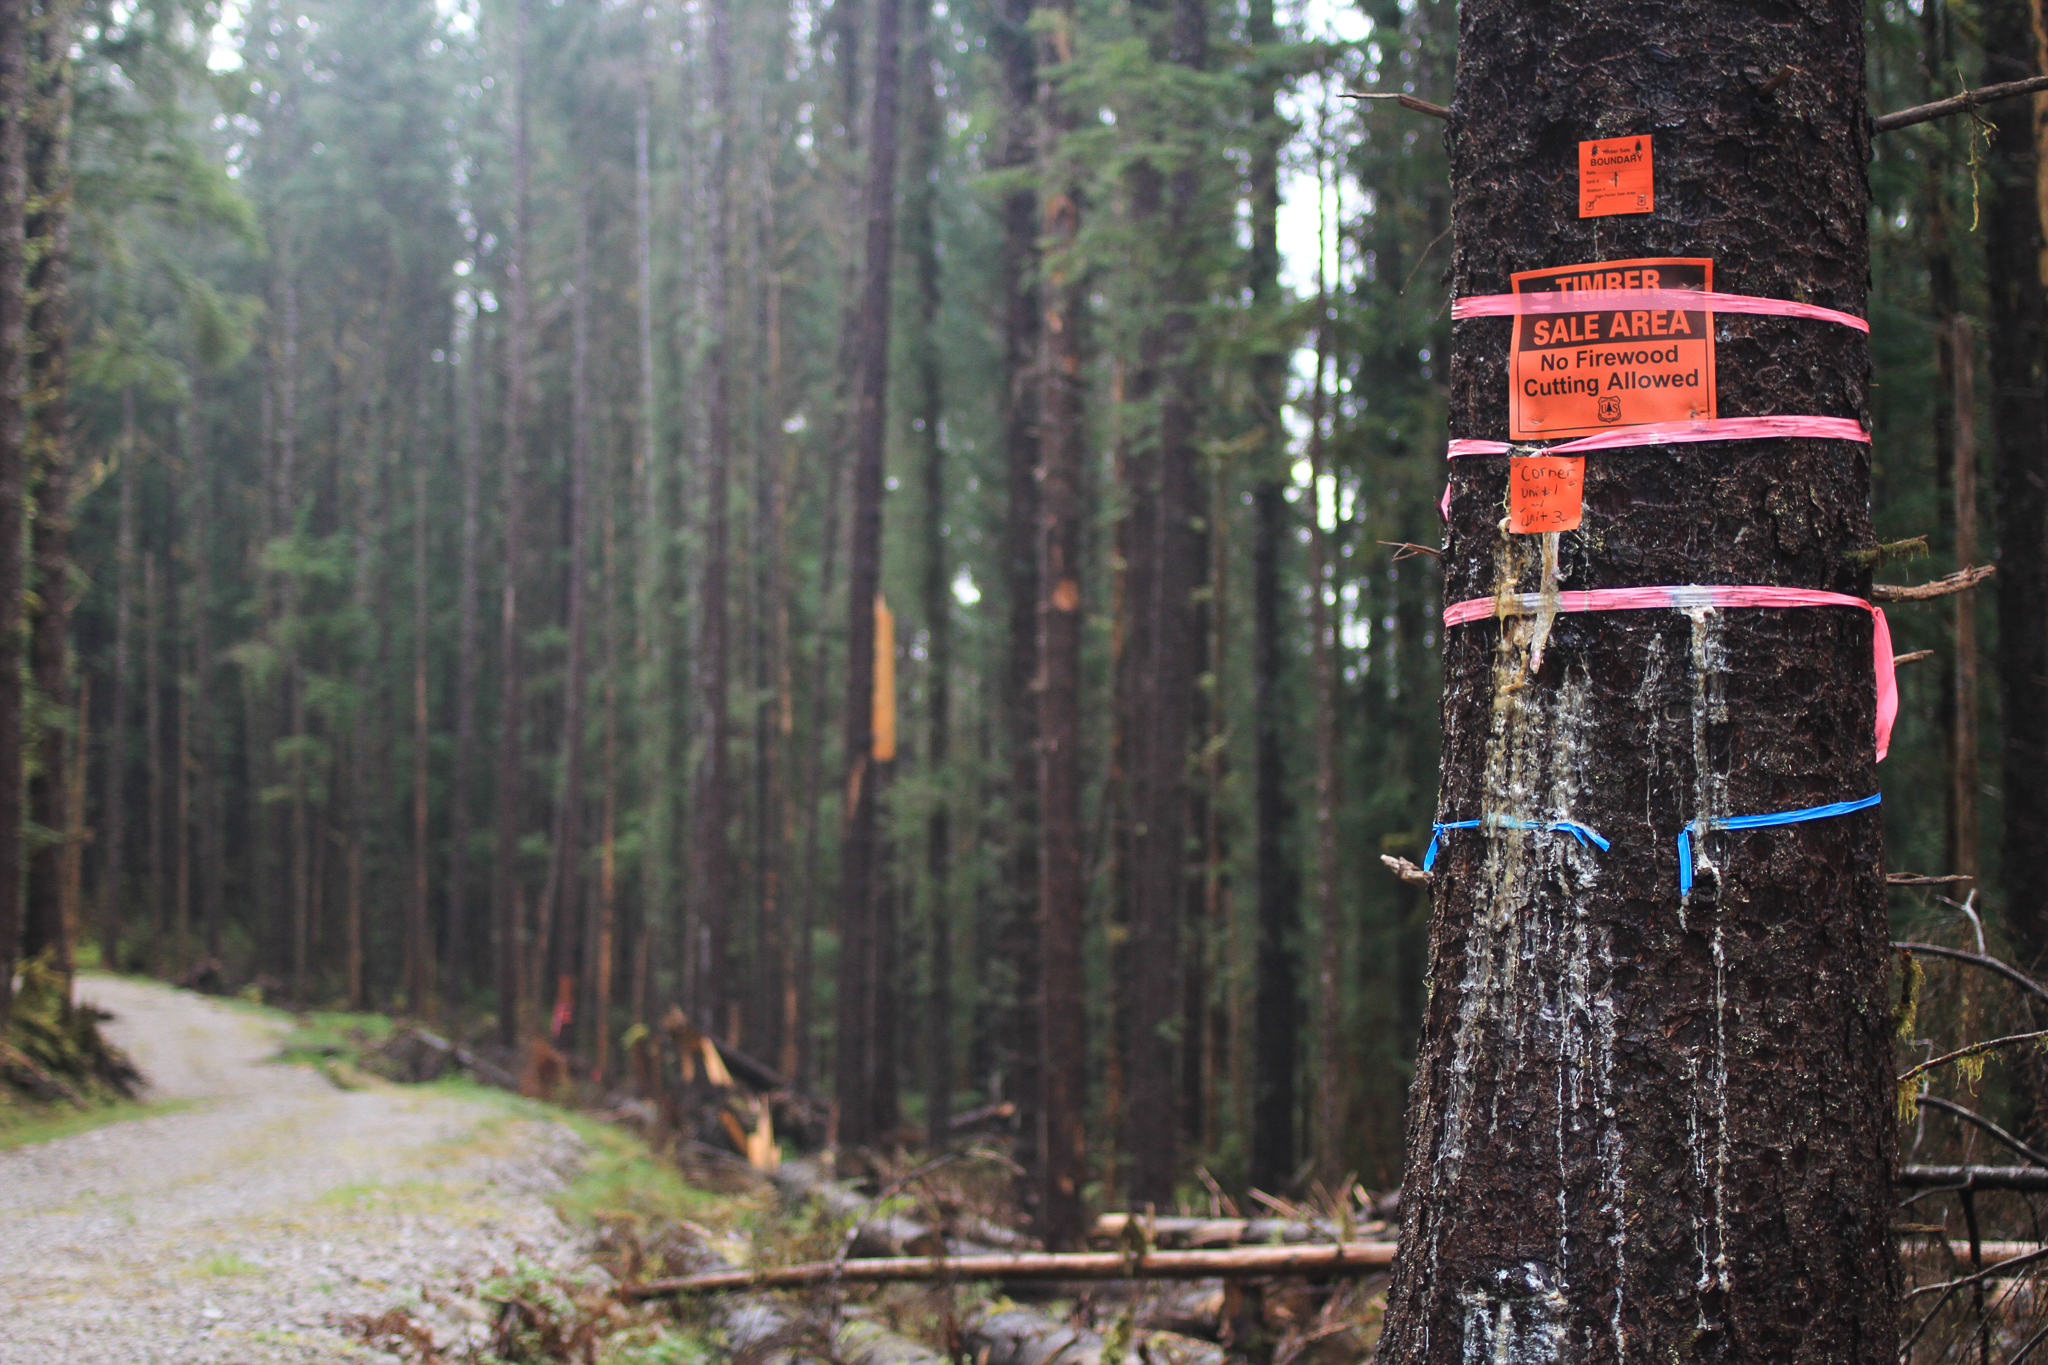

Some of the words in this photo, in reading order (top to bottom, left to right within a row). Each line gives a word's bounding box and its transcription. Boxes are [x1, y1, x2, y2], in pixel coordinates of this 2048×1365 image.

[1590, 154, 1643, 166] BOUNDARY
[1555, 269, 1660, 303] TIMBER
[1533, 314, 1599, 346] SALE
[1609, 309, 1691, 338] AREA
[1541, 354, 1569, 371] No
[1576, 345, 1679, 368] Firewood
[1524, 376, 1599, 397] Cutting
[1607, 369, 1699, 390] Allowed
[1521, 465, 1576, 482] Corner
[1521, 512, 1548, 527] Unit
[1552, 510, 1563, 524] 3
